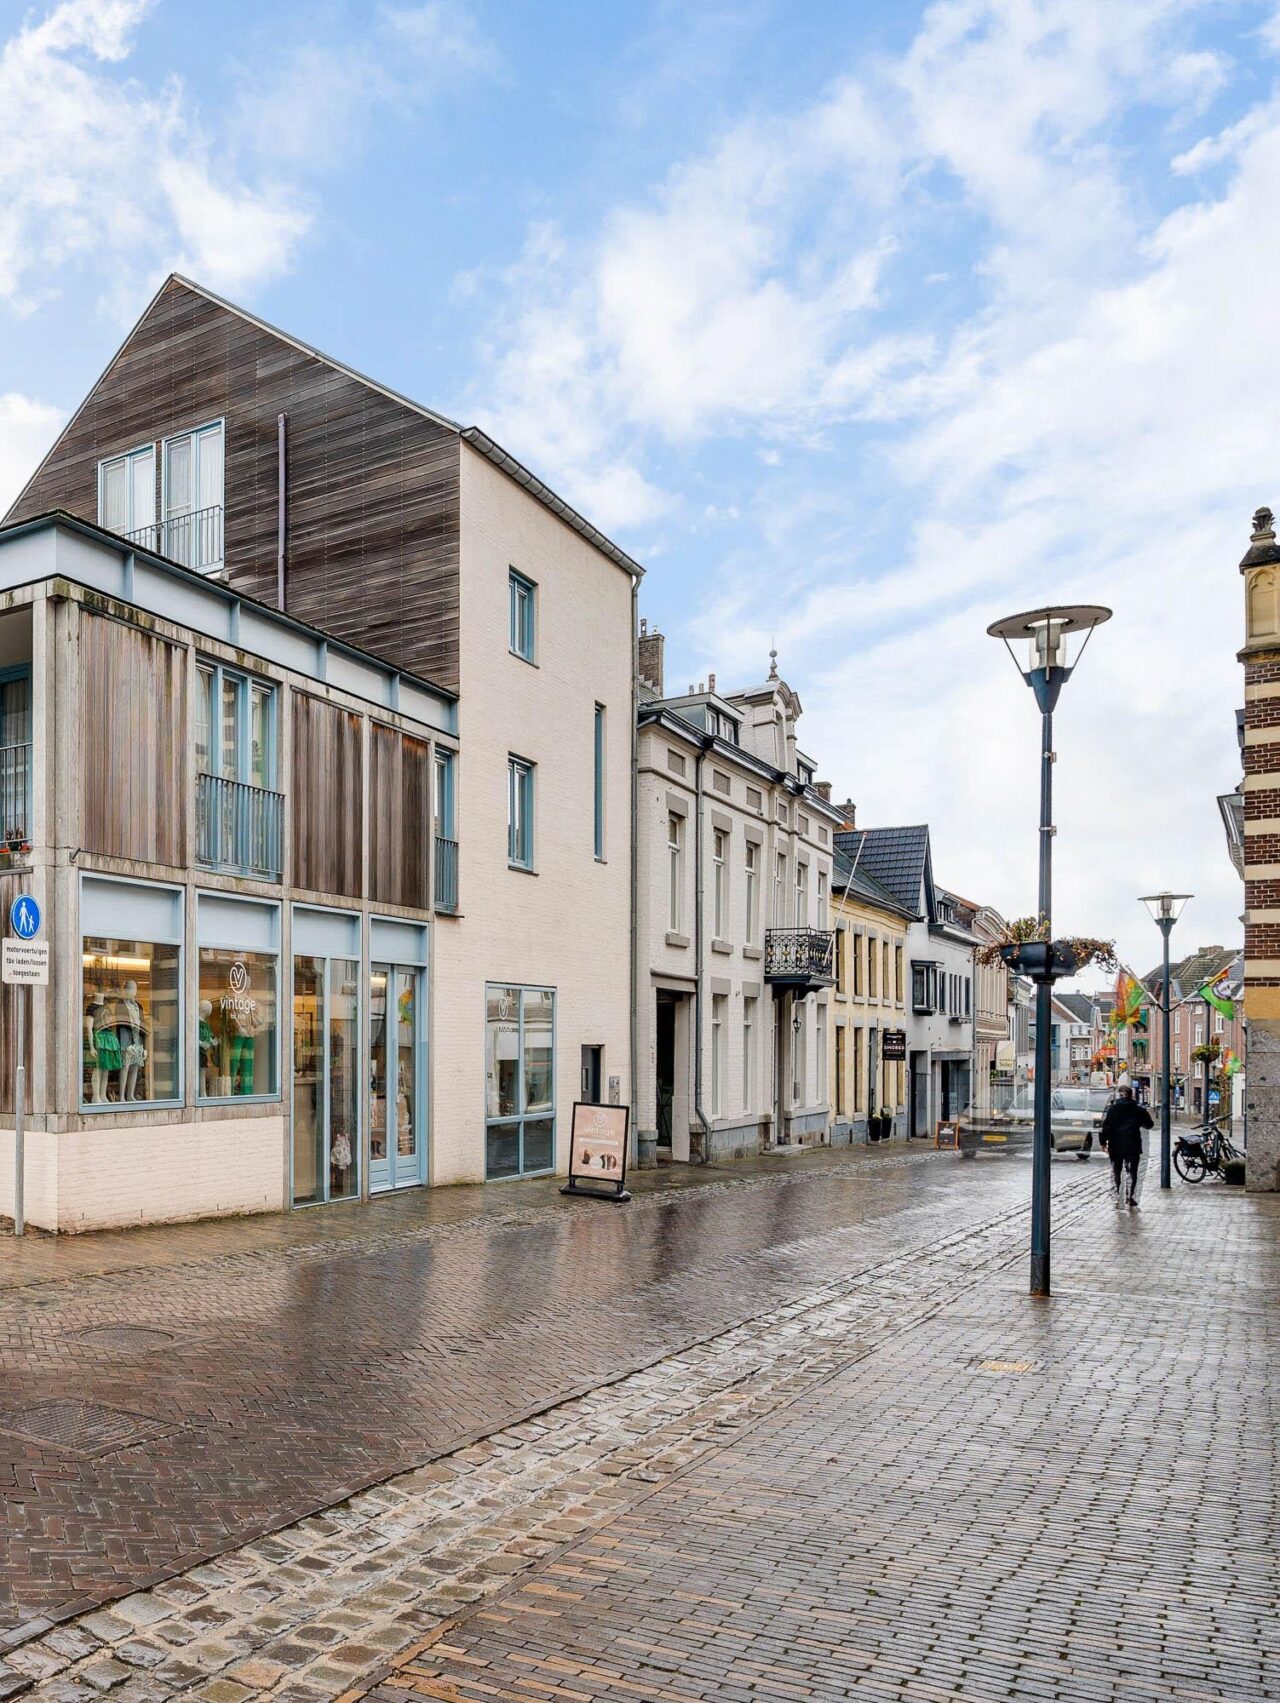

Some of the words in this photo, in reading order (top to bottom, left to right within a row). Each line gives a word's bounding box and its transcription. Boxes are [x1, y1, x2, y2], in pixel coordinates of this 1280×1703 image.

[6, 946, 48, 956] motorvoertuigen
[12, 969, 41, 978] toegestaan
[220, 994, 257, 1014] vintage
